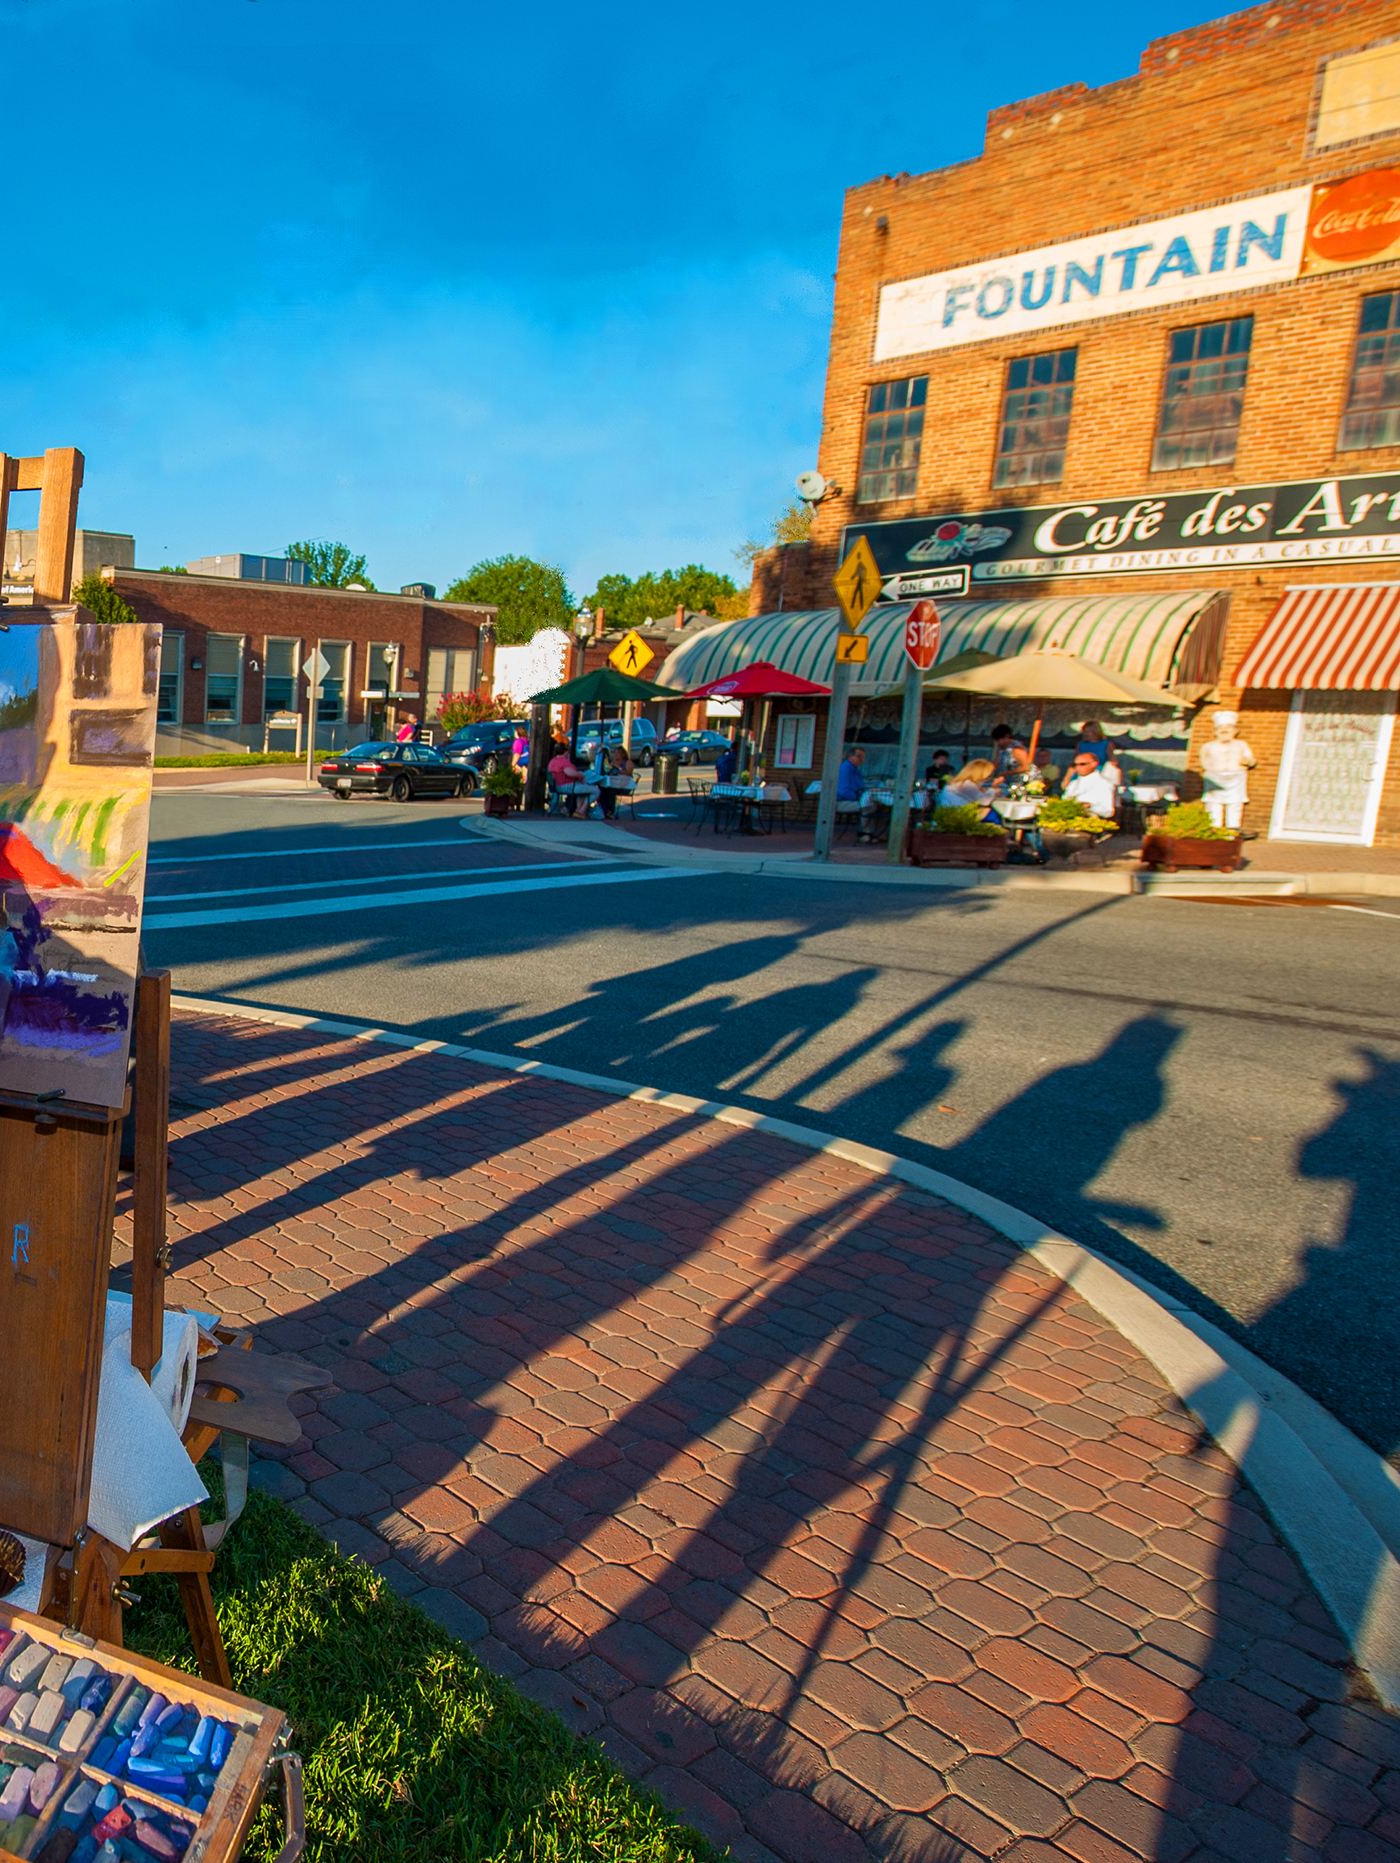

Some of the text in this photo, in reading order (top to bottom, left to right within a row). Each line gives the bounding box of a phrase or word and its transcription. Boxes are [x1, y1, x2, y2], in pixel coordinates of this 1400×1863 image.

[942, 213, 1288, 328] FOUNTAIN
[1034, 500, 1167, 554] Café
[1180, 489, 1273, 537] des
[986, 538, 1393, 576] GOURMET DINING IN A CASUAL
[901, 577, 959, 592] ONE WAY
[907, 621, 939, 647] STOP
[11, 1224, 29, 1263] R
